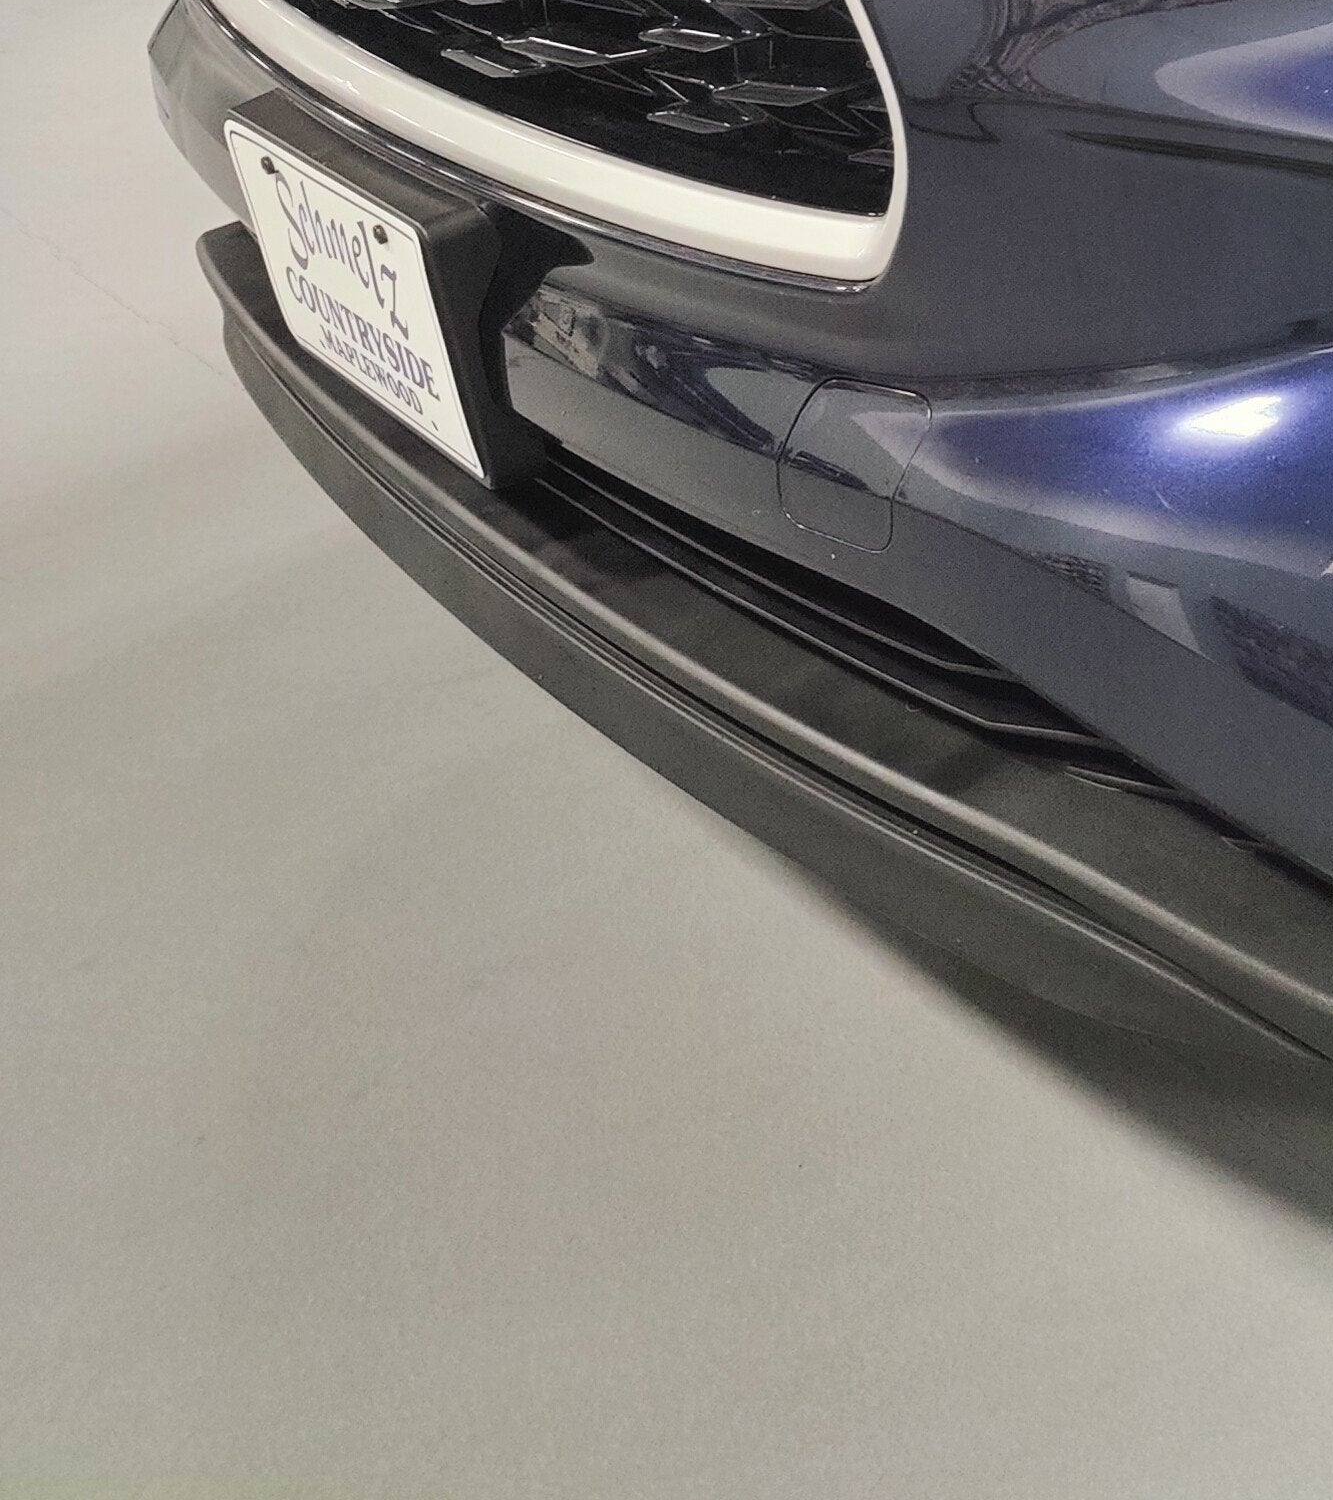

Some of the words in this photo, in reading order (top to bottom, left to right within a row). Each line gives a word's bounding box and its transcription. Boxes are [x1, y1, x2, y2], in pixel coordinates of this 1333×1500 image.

[273, 170, 409, 341] Schmelz
[285, 266, 441, 402] COUNTRYSIDE
[319, 324, 424, 415] MAPLEWOOD
